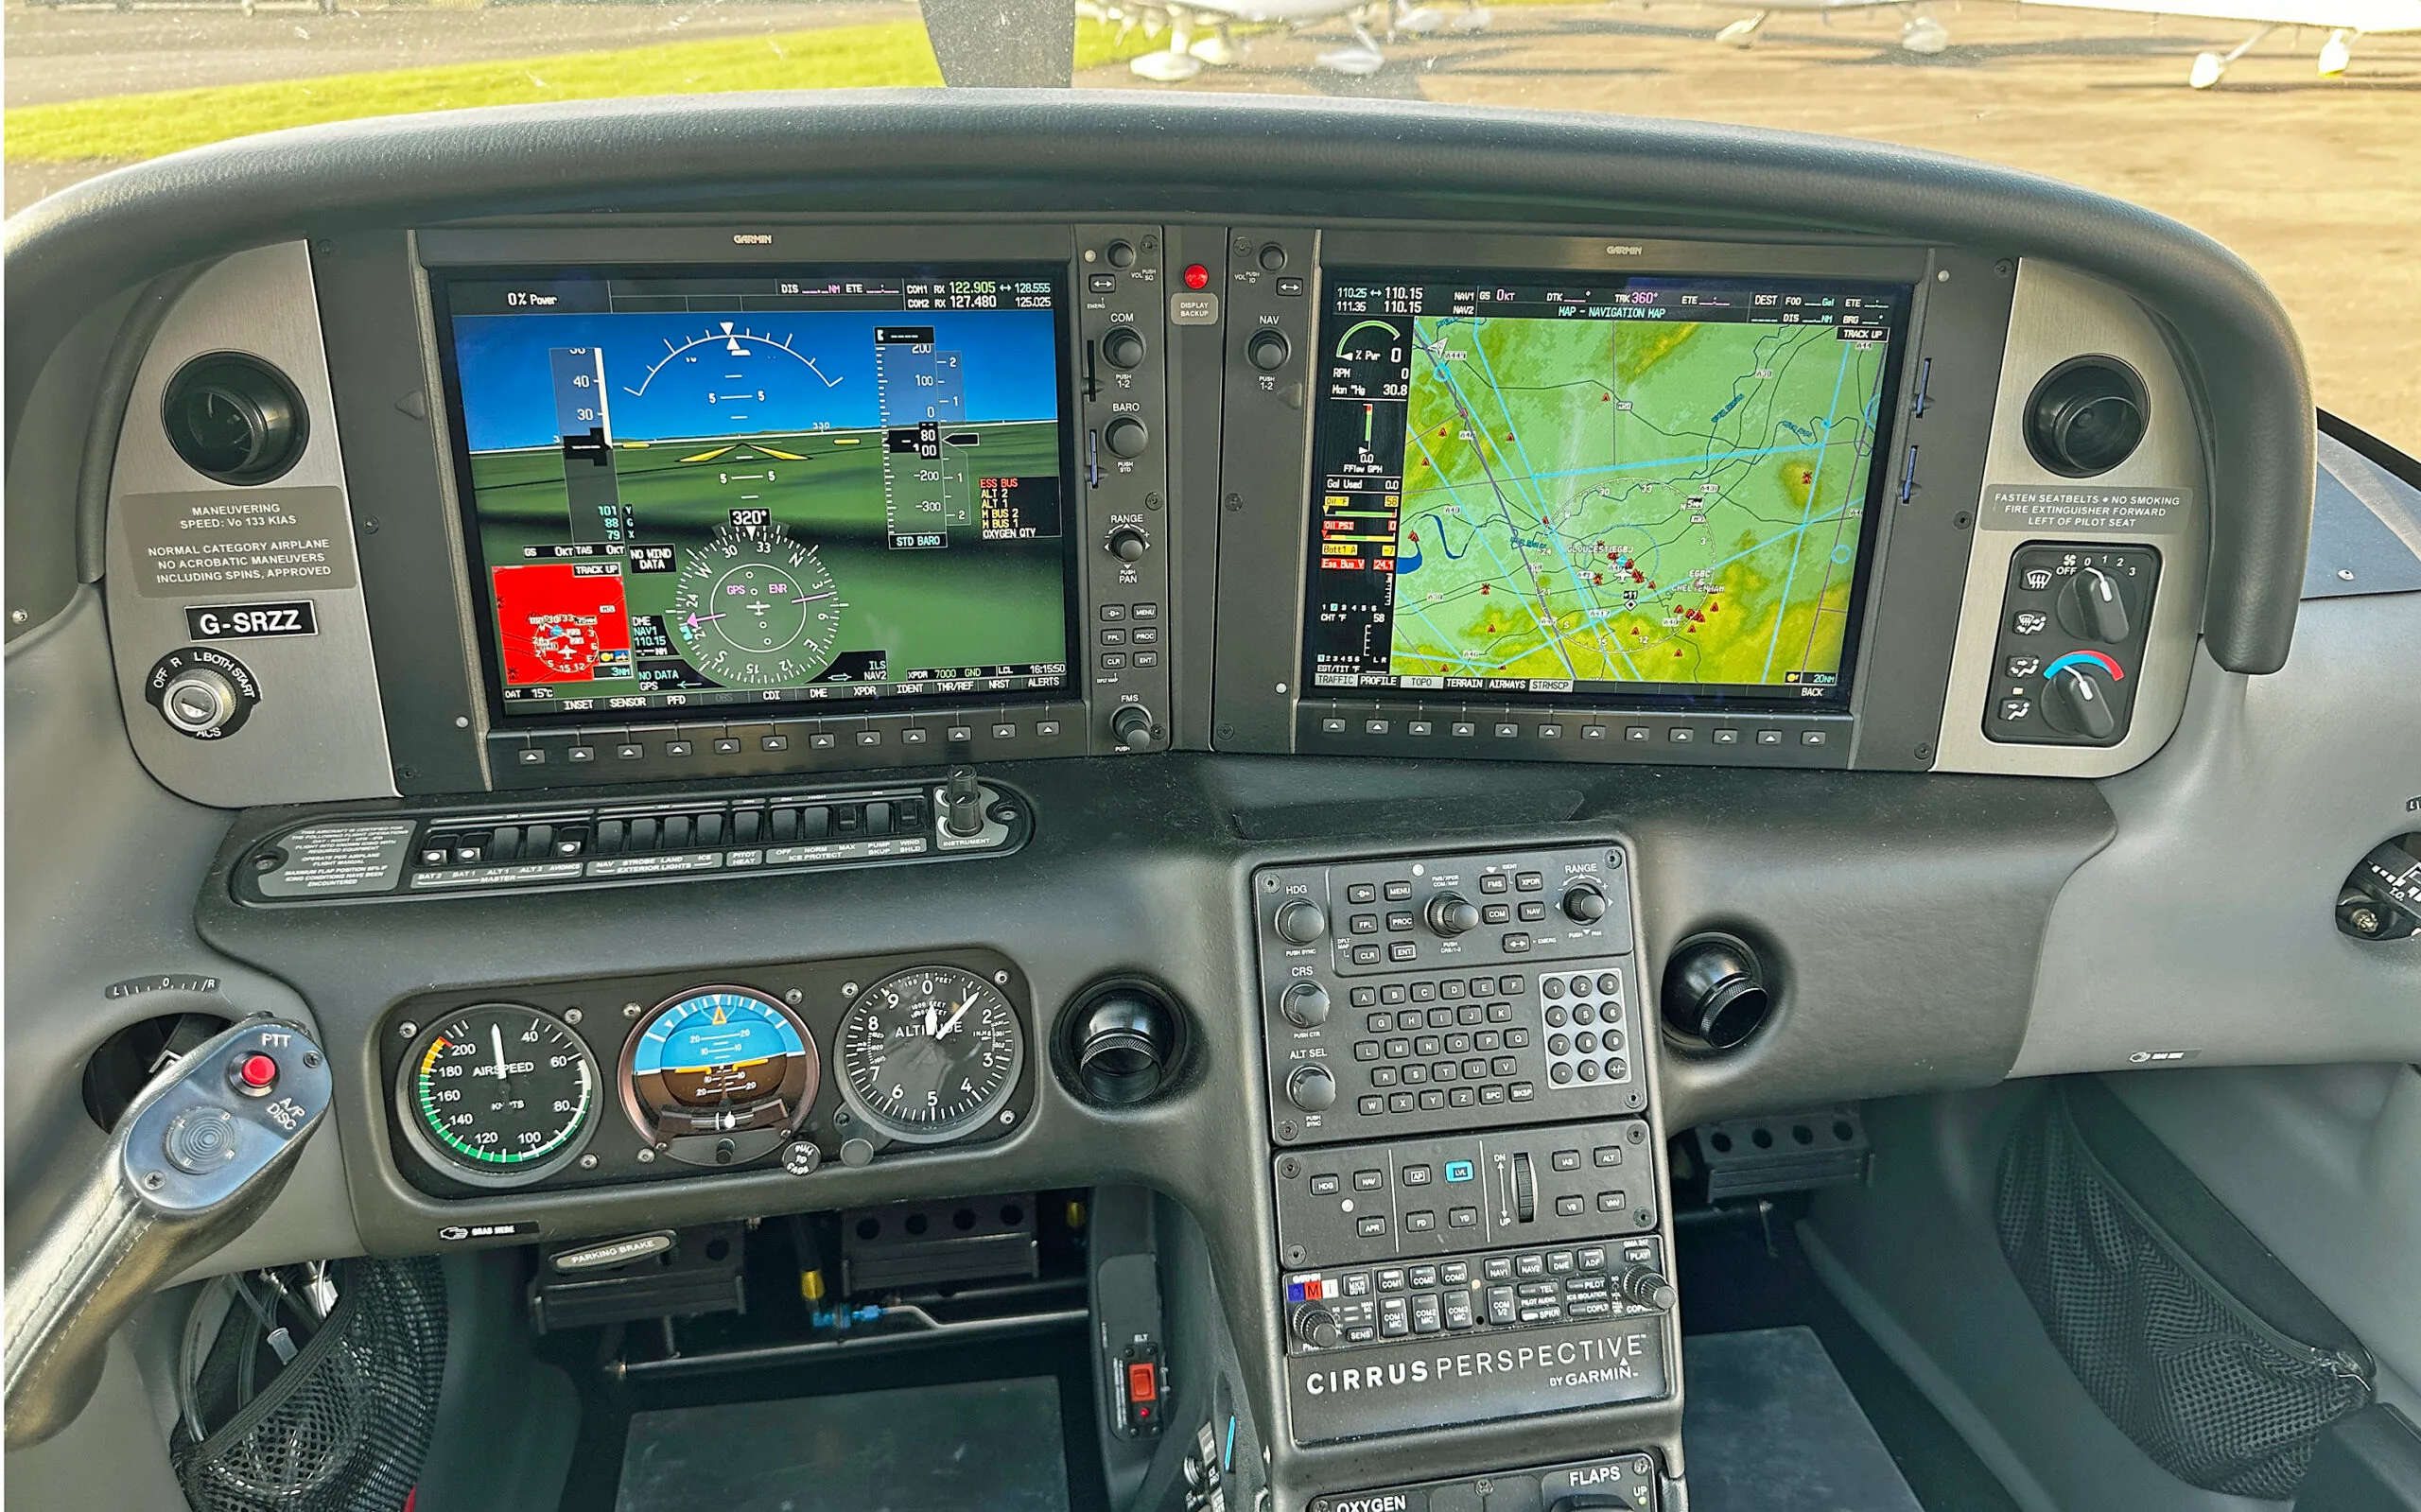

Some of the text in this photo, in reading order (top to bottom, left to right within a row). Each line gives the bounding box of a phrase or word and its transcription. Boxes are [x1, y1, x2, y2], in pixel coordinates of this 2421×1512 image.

[733, 235, 772, 244] GARMIN
[1607, 246, 1643, 255] GARMIN
[907, 282, 1050, 294] COM1 122.905 128.555
[508, 292, 557, 306] 0% Power
[1337, 287, 1474, 301] 110.25 110.15 NAV1
[908, 296, 1051, 308] COM2 127.480 125.025
[1754, 295, 1778, 305] DEST
[1180, 302, 1209, 310] DISPLAY
[1336, 301, 1473, 315] 111.35 110.15 NAV2
[1110, 313, 1134, 322] COM
[1558, 306, 1665, 319] MAP NAVIGATION MAP
[1259, 316, 1280, 324] NAV
[1844, 329, 1882, 339] TRACK UP
[1333, 368, 1350, 378] RPM
[1383, 384, 1408, 396] 30.8
[1112, 403, 1141, 412] BARO
[980, 478, 1019, 488] ESS BUS
[1327, 480, 1399, 490] Gal Used 0.0
[981, 489, 1008, 498] ALT 2
[1994, 493, 2180, 506] FASTEN SEATBELTS NO SMOKING
[192, 504, 280, 515] MANEUVERING
[2004, 505, 2166, 516] FIRE EXTINGUISHER FORWARD
[180, 515, 297, 530] SPEED: Vo 133 KIAS
[1110, 514, 1144, 523] RANGE
[2028, 516, 2136, 528] LEFT OF PILOT SEAT
[983, 528, 1036, 539] OXYGEN QTY
[897, 535, 940, 546] STD BARO
[148, 539, 330, 557] NORMAL CATEGORY AIRPLANE
[630, 549, 671, 559] NO WIND
[159, 553, 324, 569] NO ACROBATIC MANEUVERS
[639, 560, 666, 569] DATA
[1374, 560, 1393, 569] 24.1
[157, 566, 332, 583] INCLUDING SPINS, APPROVED
[575, 565, 618, 574] TRACK UP
[2055, 566, 2077, 575] OFF
[1119, 575, 1138, 583] PAN
[726, 585, 746, 595] GPS
[769, 583, 787, 594] ENR
[200, 609, 302, 634] G-SRZZ
[634, 626, 657, 635] NAV1
[635, 635, 666, 646] 110.15
[907, 669, 982, 679] XPDR 7000 GND
[1029, 664, 1066, 674] 16:15:50
[153, 652, 255, 699] OFF BOTH START
[1317, 675, 1354, 684] TRAFFIC
[1028, 677, 1060, 687] ALERTS
[1360, 676, 1397, 686] PROFILE
[1411, 678, 1433, 686] TOPO
[1446, 678, 1483, 688] TERRAIN
[1489, 679, 1525, 689] AIRWAYS
[1532, 681, 1569, 690] STRMSCP
[897, 684, 924, 694] IDENT
[936, 681, 974, 692] TMR/REF
[1801, 687, 1823, 697] BACK
[564, 700, 593, 710] INSET
[609, 697, 647, 708] SENSOR
[667, 695, 687, 705] PFD
[943, 838, 991, 847] INSTRUMENT
[804, 851, 843, 861] PROTECT
[617, 862, 692, 874] EXTERIOR LIGHTS
[1565, 863, 1597, 874] RANGE
[307, 878, 358, 887] ENCOUNTERED
[480, 874, 516, 883] MASTER
[1285, 885, 1307, 895] HDG
[1291, 966, 1313, 976] CRS
[895, 1021, 963, 1038] ALTIUDE
[261, 1033, 291, 1047] PTT
[451, 1043, 477, 1056] 200
[1289, 1048, 1328, 1060] ALT SEL
[439, 1066, 462, 1077] 180
[473, 1062, 534, 1077] AIRSPEED
[437, 1089, 461, 1102] 160
[279, 1097, 305, 1118] A/P
[266, 1103, 297, 1130] DISC
[449, 1113, 473, 1125] 140
[475, 1131, 498, 1144] 120
[518, 1131, 542, 1143] 100
[495, 1225, 514, 1235] HERE
[571, 1240, 654, 1264] PARKING BRAKE
[1630, 1251, 1648, 1260] PLAY
[1413, 1277, 1434, 1286] COM2
[1584, 1279, 1605, 1289] PILOT
[1134, 1334, 1149, 1343] ELT
[1350, 1332, 1370, 1341] SENS
[1305, 1359, 1428, 1396] CIRRUS
[1549, 1376, 1562, 1387] BY
[1569, 1467, 1621, 1486] FLAPS
[1632, 1486, 1647, 1498] UP
[1336, 1495, 1406, 1512] OXYGEN
